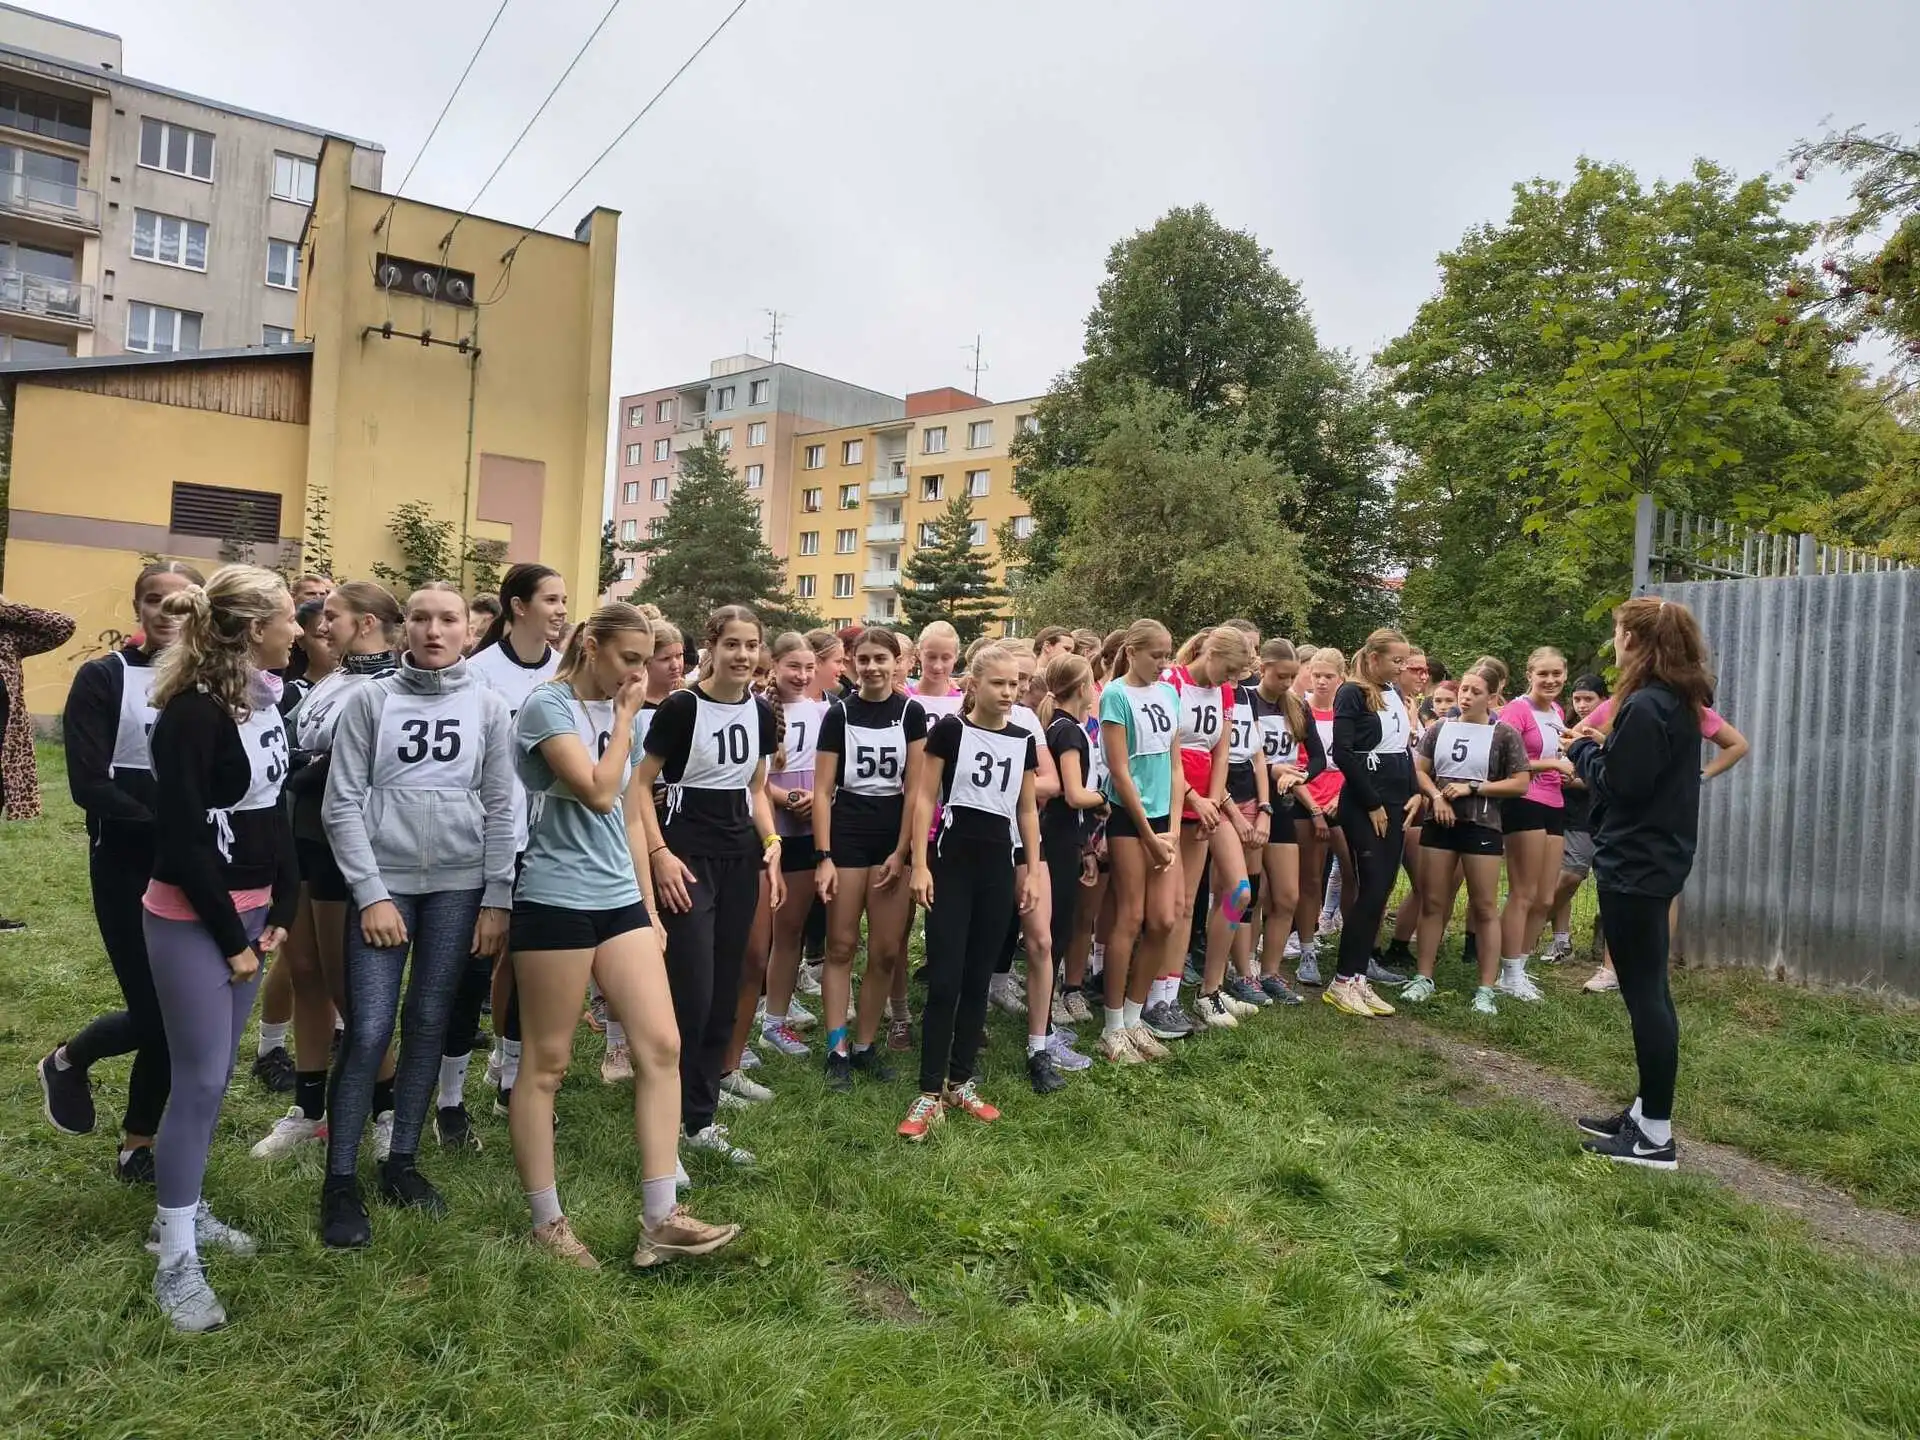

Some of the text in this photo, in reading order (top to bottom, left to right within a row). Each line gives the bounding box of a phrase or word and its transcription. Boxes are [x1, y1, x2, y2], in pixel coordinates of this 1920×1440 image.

[1141, 704, 1171, 733] 18
[1192, 705, 1217, 735] 16
[397, 719, 461, 763] 35
[712, 724, 750, 765] 10
[791, 722, 806, 752] 7
[1262, 731, 1293, 757] 59
[1451, 739, 1470, 762] 5
[856, 746, 898, 779] 55
[971, 752, 1012, 792] 31
